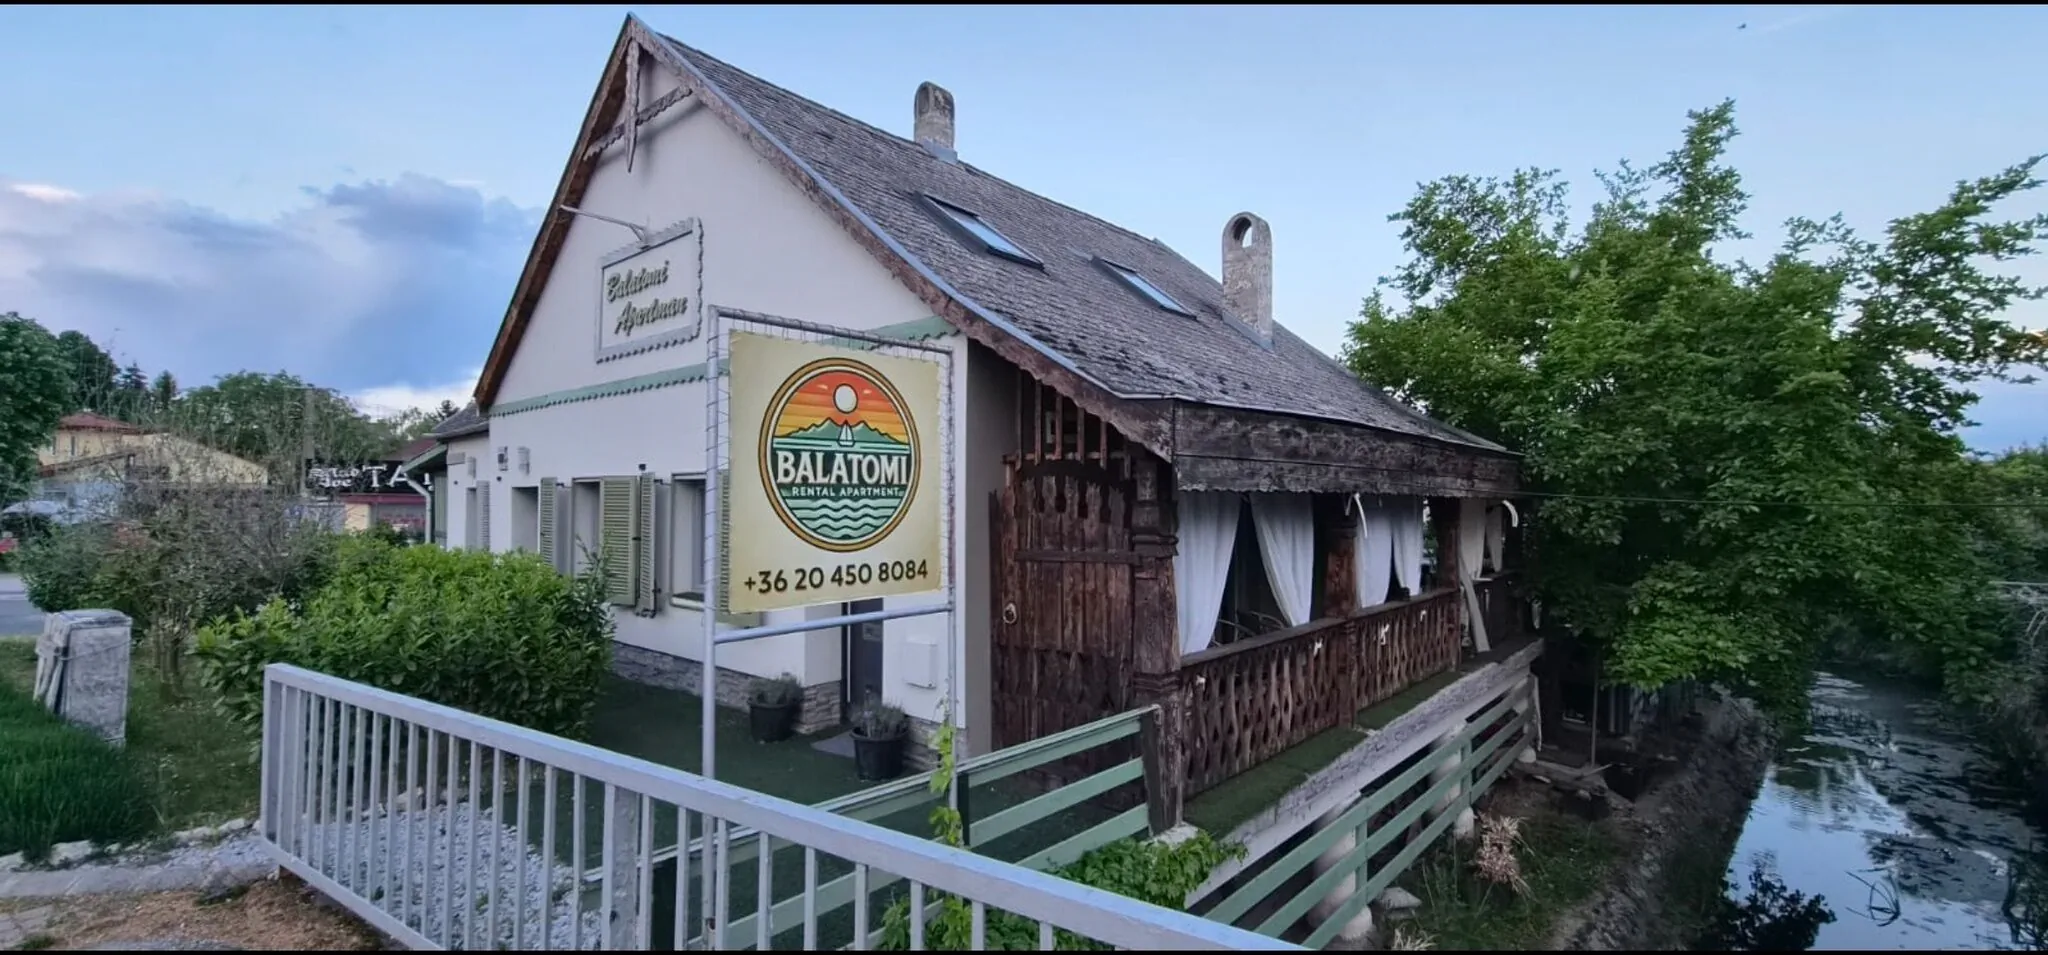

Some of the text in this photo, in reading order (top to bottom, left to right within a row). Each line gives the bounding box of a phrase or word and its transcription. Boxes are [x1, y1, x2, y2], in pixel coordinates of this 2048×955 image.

[776, 450, 908, 485] BALATOMI
[792, 486, 899, 497] RENTAL APARTMENT
[744, 559, 928, 594] +36 20 450 8084
